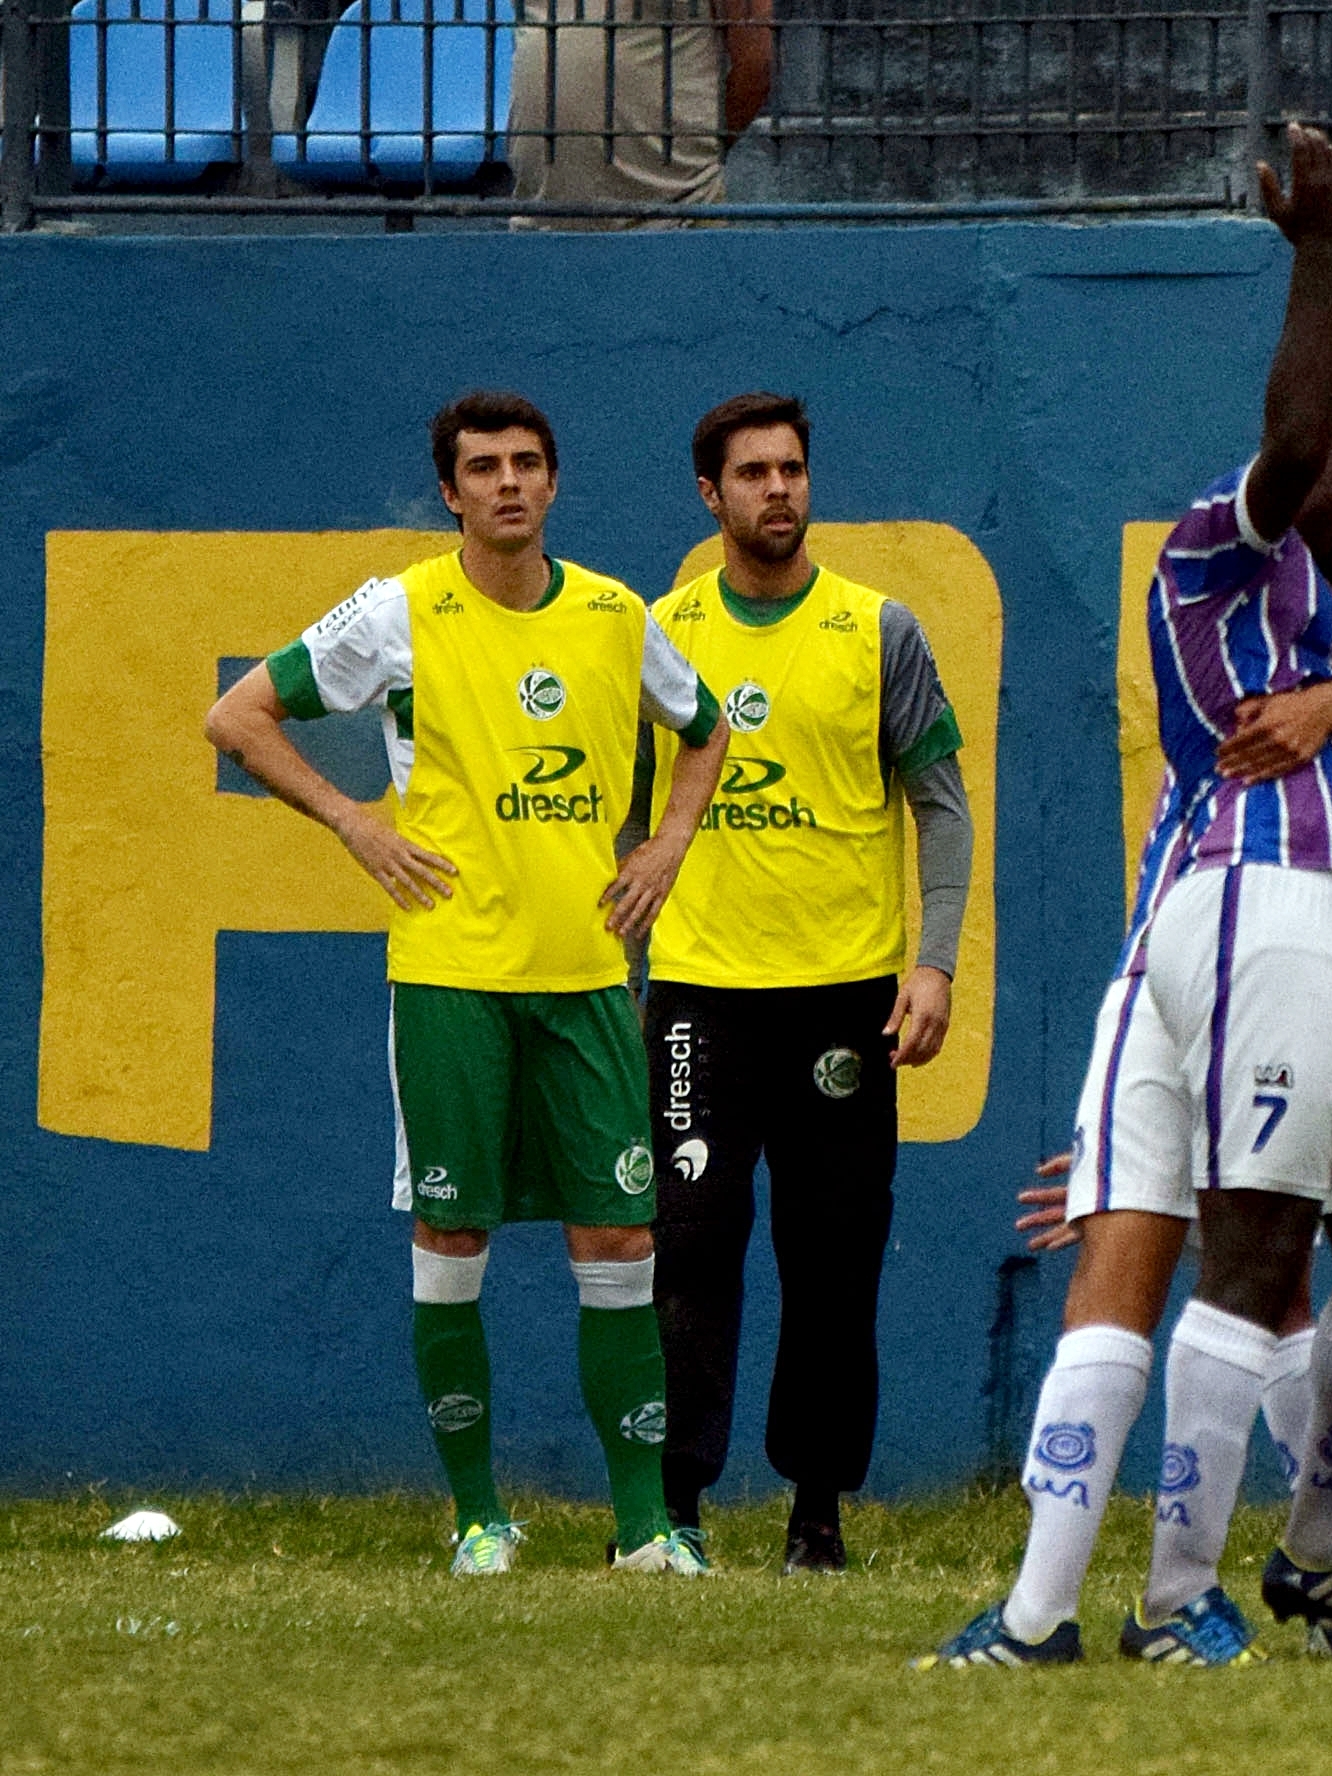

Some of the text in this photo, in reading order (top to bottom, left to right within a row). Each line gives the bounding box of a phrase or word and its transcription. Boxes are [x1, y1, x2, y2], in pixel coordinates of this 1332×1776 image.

[663, 1021, 692, 1131] dresch
[1251, 1094, 1288, 1154] 7
[417, 1180, 458, 1200] dresch
